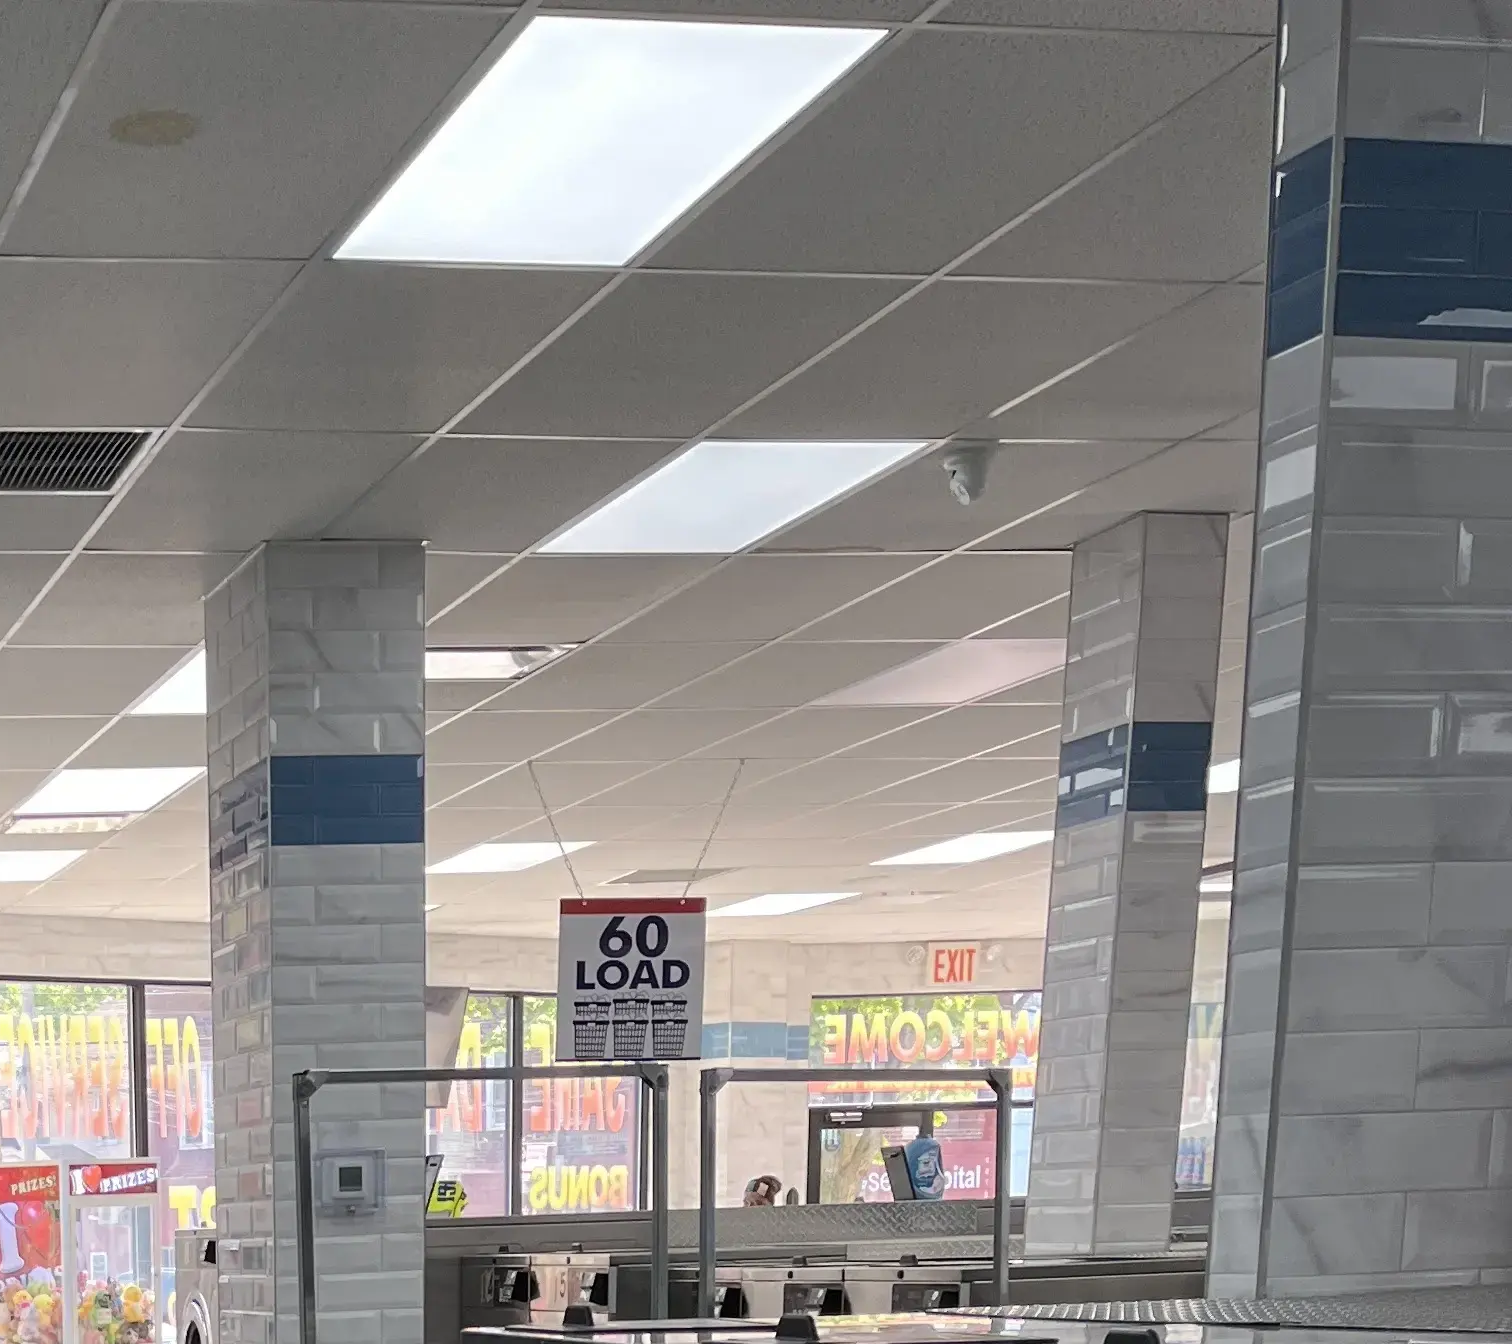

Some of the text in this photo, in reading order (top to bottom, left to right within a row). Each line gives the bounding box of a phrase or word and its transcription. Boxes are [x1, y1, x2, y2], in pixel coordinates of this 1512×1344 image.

[599, 915, 669, 958] 60
[576, 959, 690, 990] LOAD
[933, 948, 976, 983] EXIT
[10, 1175, 56, 1196] PRIZES!
